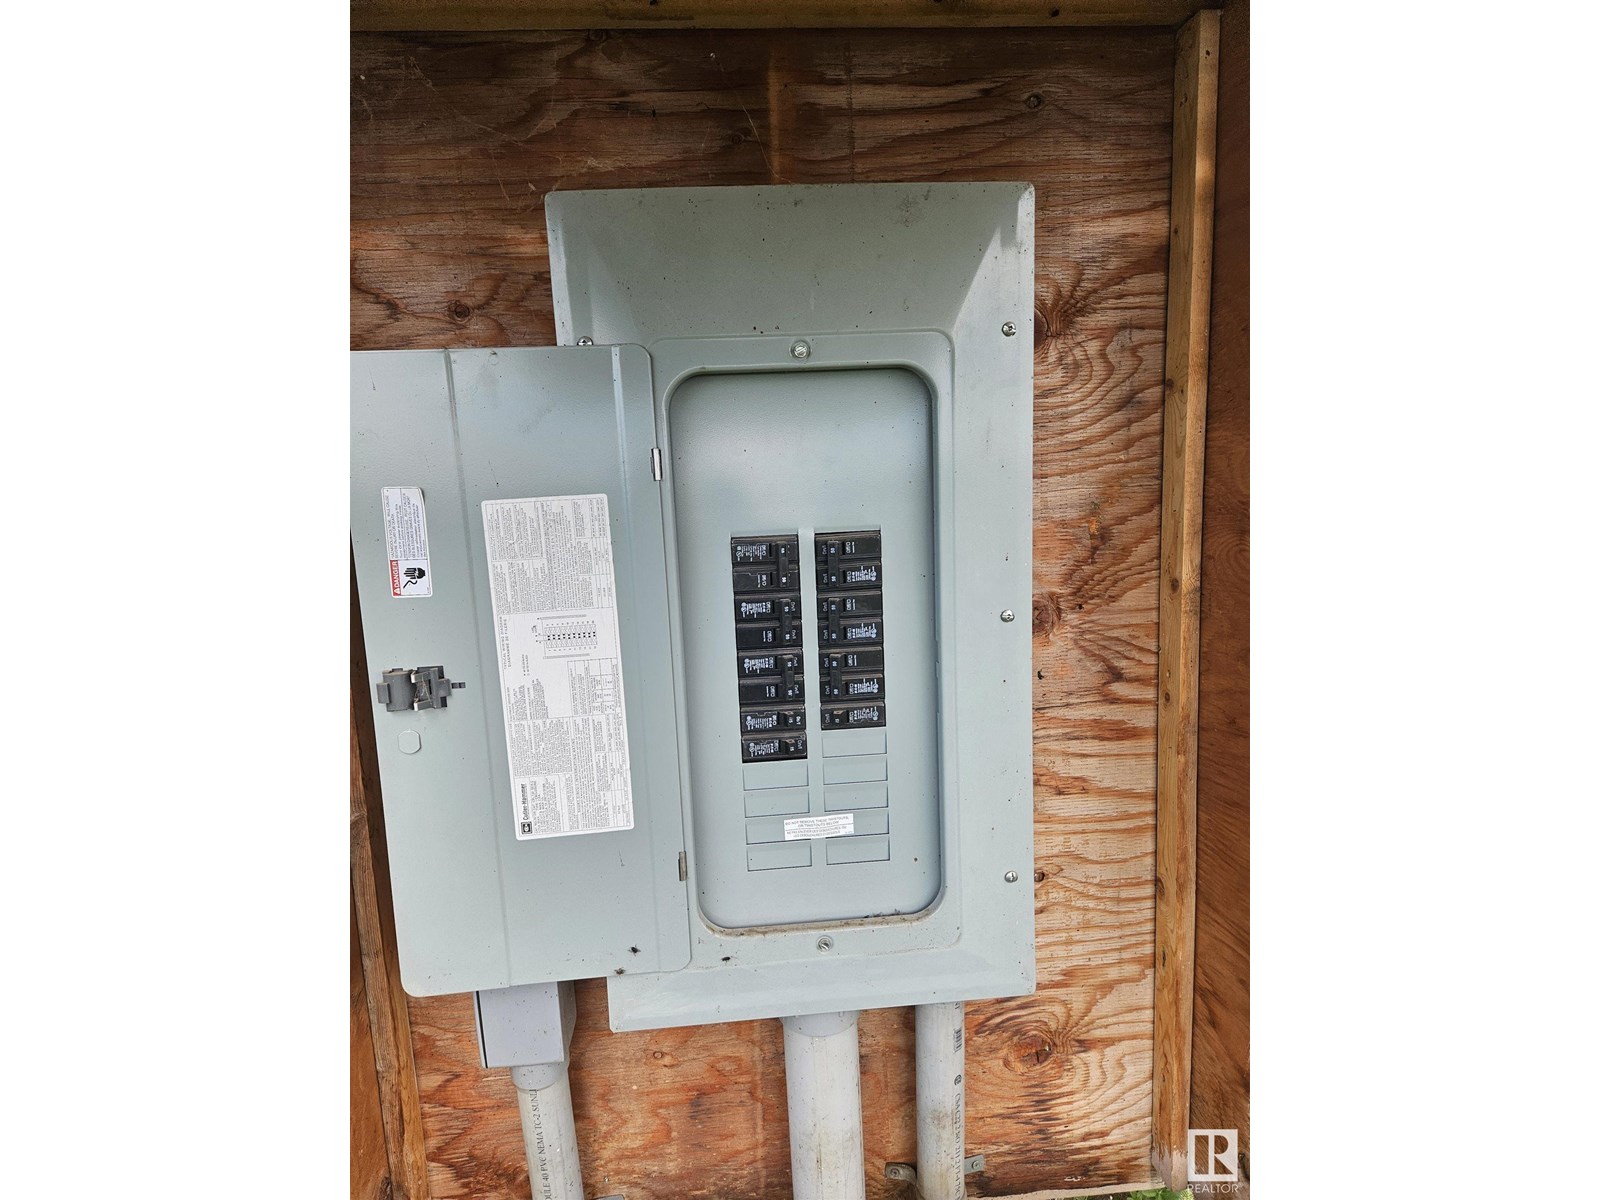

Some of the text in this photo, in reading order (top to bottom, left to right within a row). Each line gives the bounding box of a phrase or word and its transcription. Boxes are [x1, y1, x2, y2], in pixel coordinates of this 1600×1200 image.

[533, 1114, 542, 1129] TC-2
[536, 1132, 546, 1154] NEMA
[539, 1156, 548, 1171] PVC
[542, 1173, 549, 1181] 40
